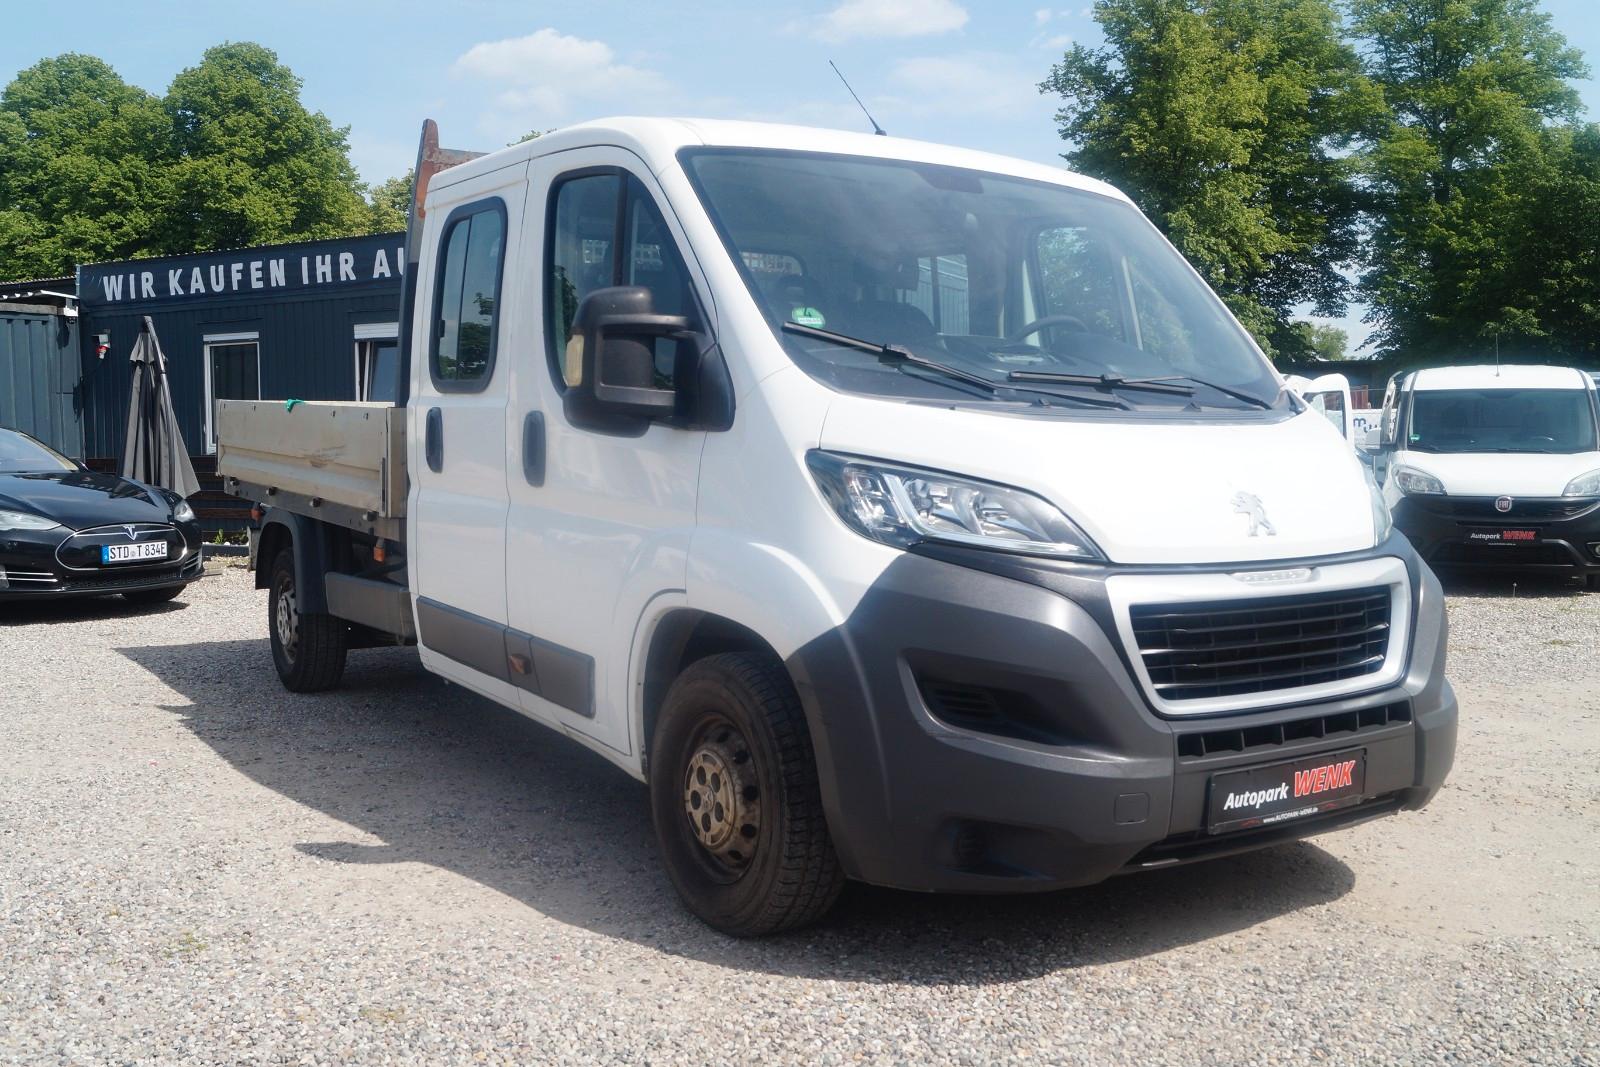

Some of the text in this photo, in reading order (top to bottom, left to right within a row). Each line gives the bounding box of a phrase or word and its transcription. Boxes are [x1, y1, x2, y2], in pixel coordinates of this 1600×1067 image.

[103, 271, 156, 301] WIR
[168, 258, 286, 296] KAUFEN
[301, 251, 356, 285] IHR
[110, 543, 165, 559] STD T 834E
[1470, 532, 1500, 540] Autopark
[1224, 760, 1356, 810] Autopark WENK
